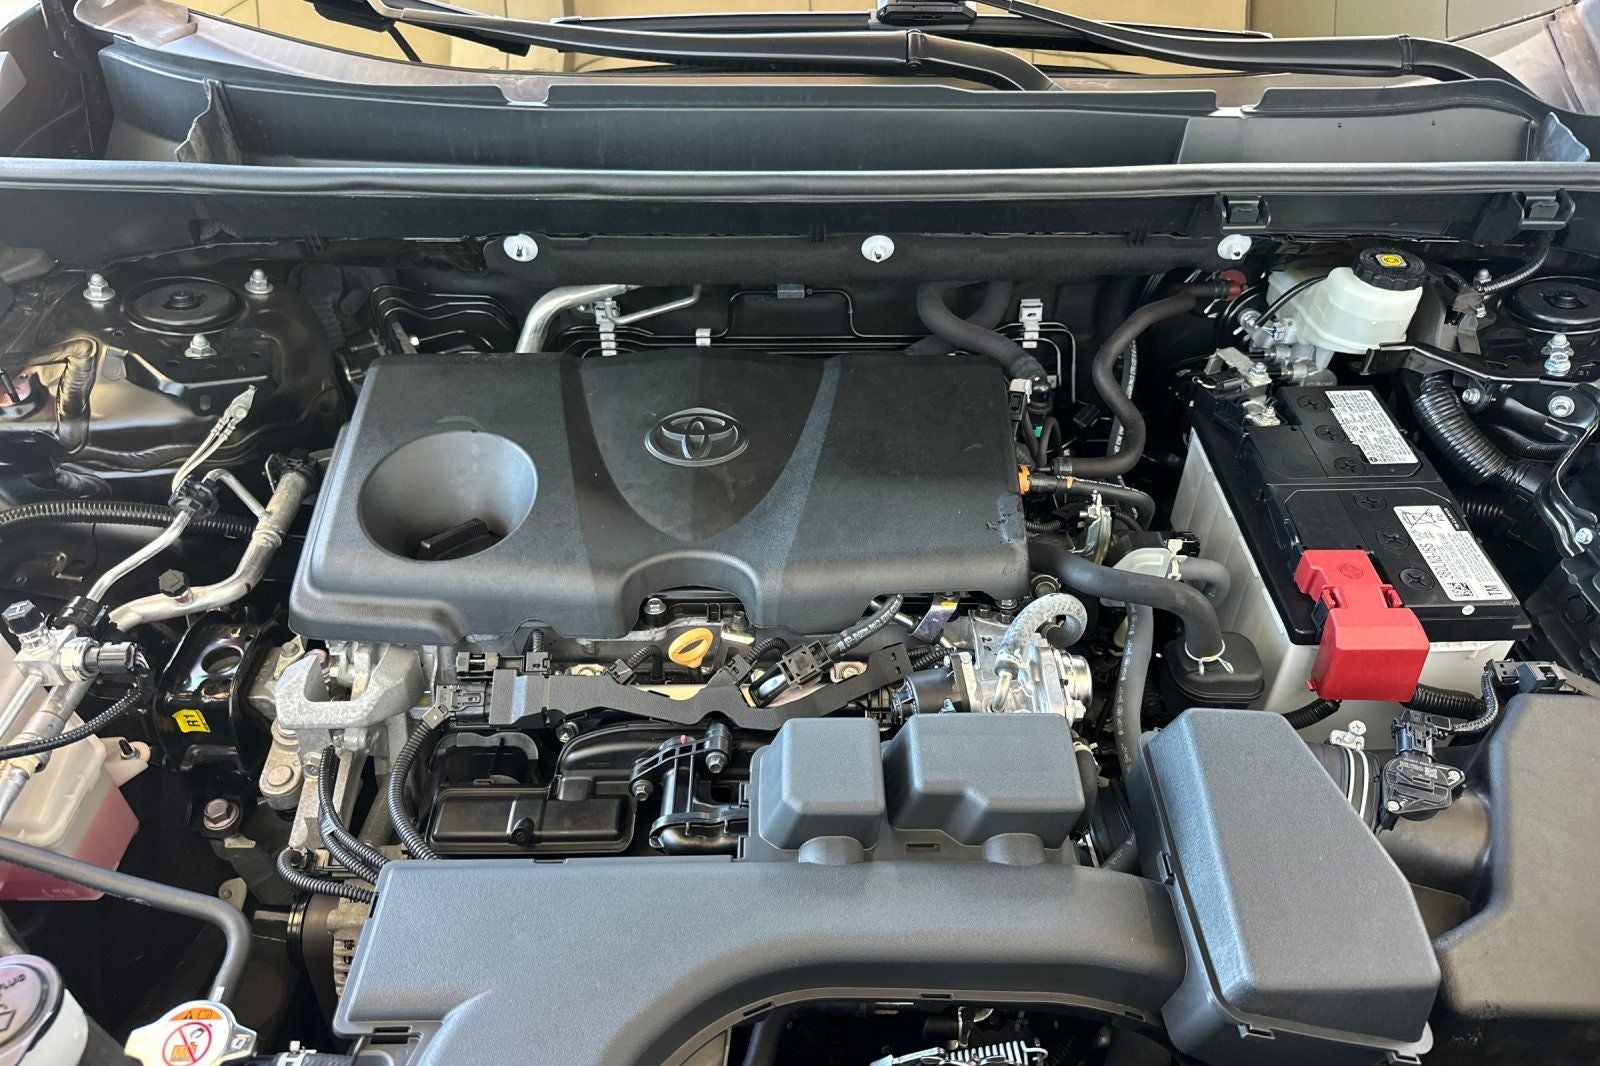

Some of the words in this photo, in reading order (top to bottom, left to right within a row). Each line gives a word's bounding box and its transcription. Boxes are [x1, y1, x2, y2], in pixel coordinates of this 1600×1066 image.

[1436, 514, 1446, 522] Pb
[1484, 584, 1503, 596] TM
[7, 602, 28, 616] H
[183, 714, 200, 727] R1
